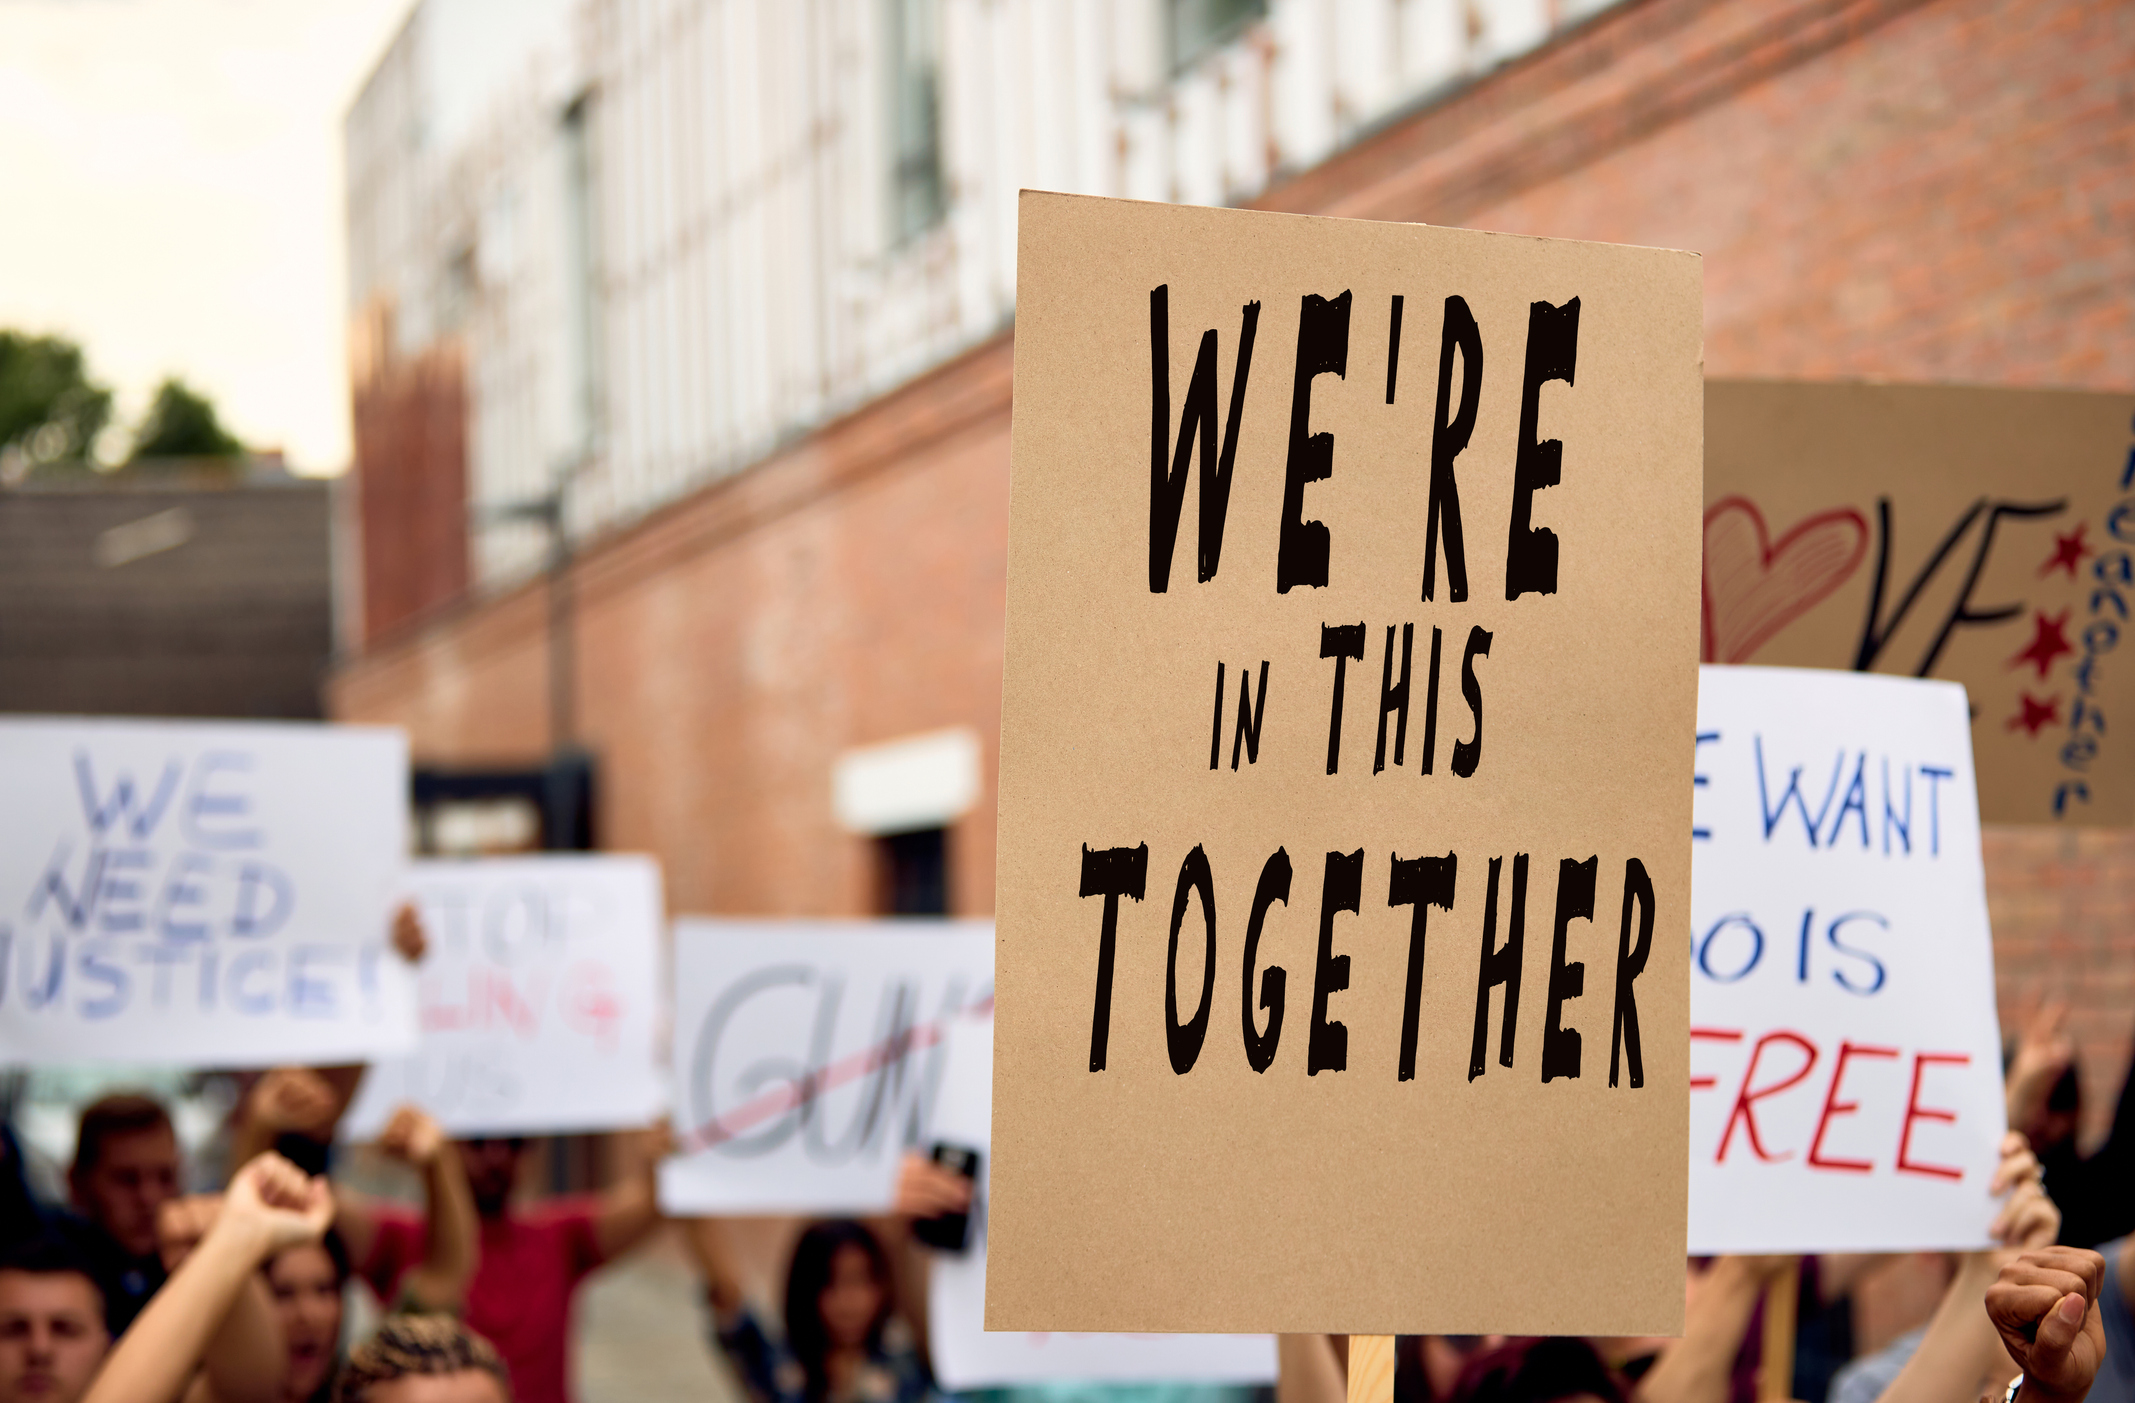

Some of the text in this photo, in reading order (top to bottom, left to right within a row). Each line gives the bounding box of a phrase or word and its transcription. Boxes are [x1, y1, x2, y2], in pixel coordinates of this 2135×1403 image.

[1149, 284, 1580, 602] WE'RE
[1210, 621, 1493, 778] IN THIS
[69, 741, 269, 851] WE
[1754, 733, 1955, 858] WANT
[24, 833, 297, 945] NEED
[1796, 907, 1891, 996] IS
[1079, 841, 1655, 1088] TOGETHER
